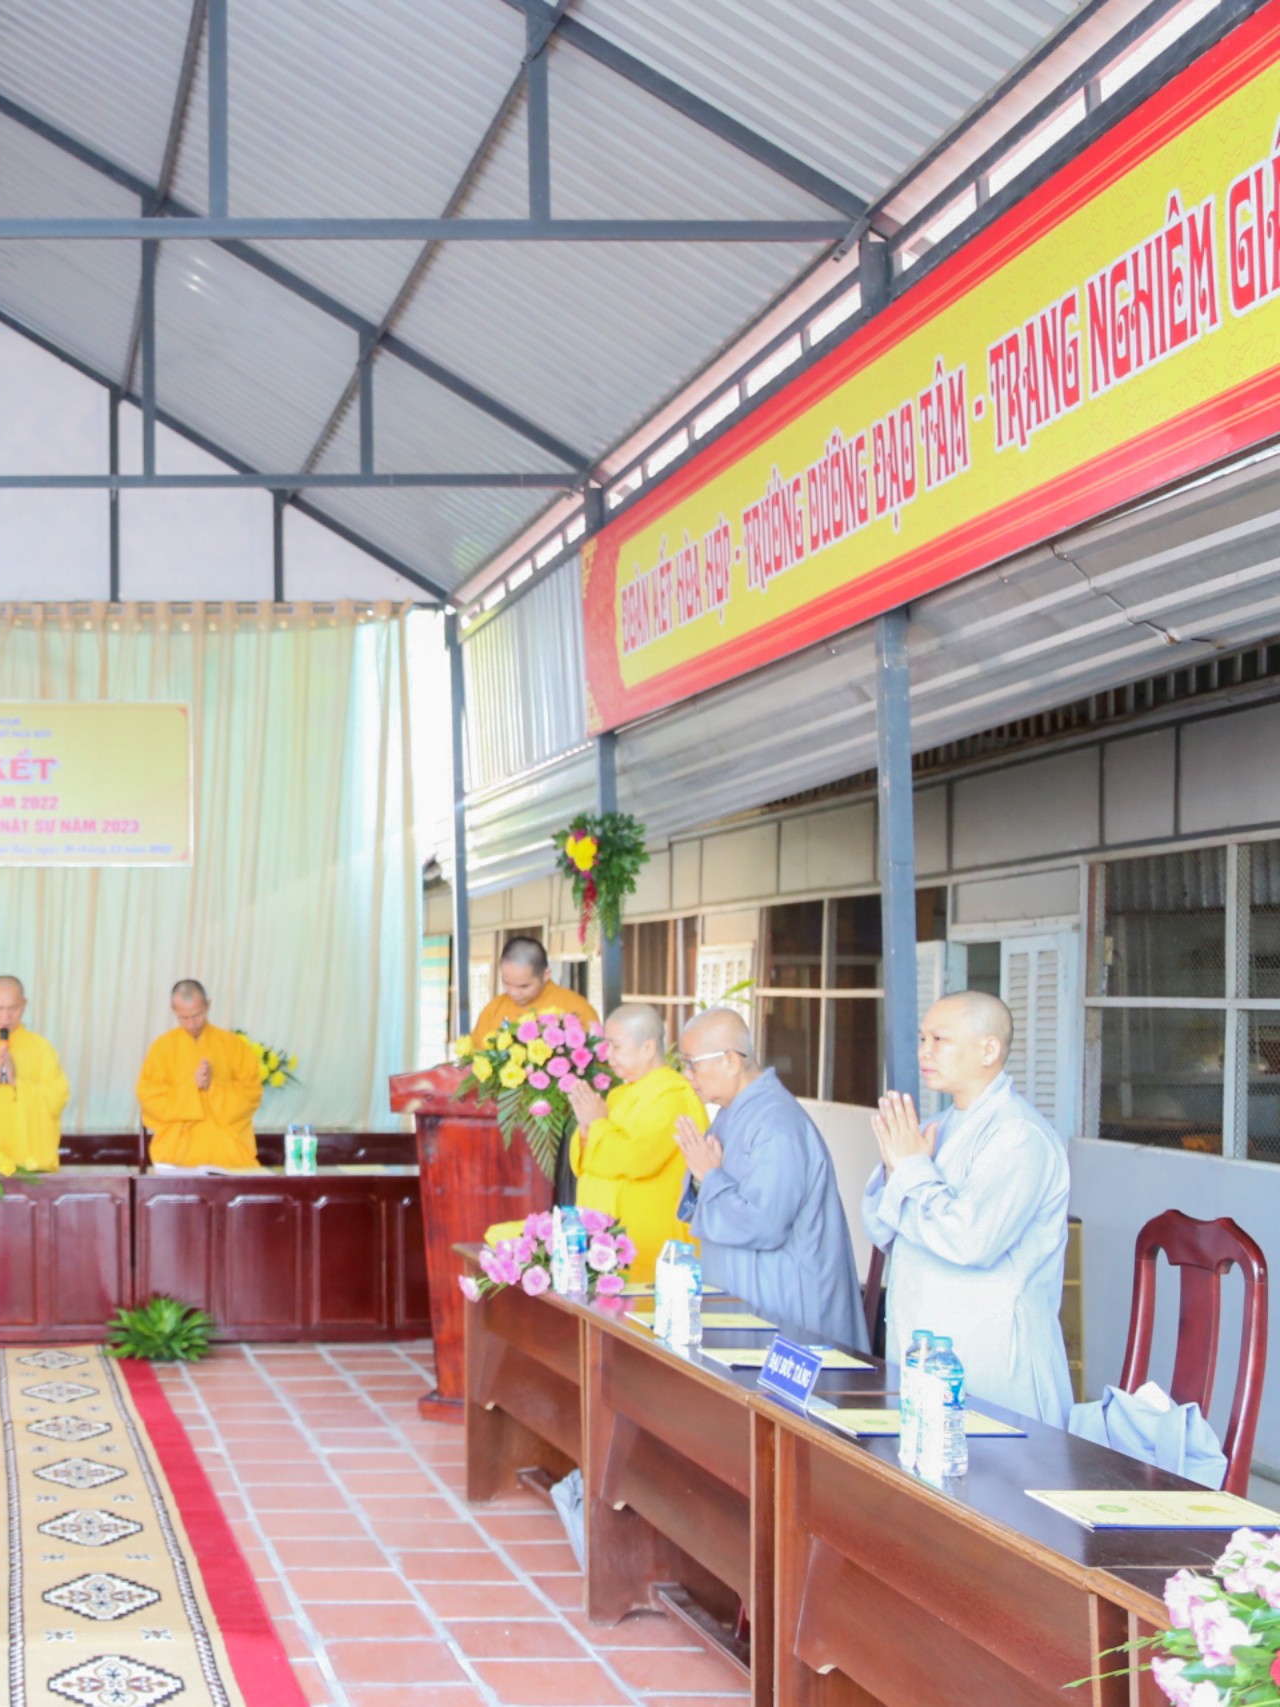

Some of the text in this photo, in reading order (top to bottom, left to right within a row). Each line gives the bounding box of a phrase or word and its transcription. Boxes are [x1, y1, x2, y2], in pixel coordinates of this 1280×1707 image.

[872, 403, 916, 530] ĐẠO
[920, 359, 969, 487] TÂM
[988, 292, 1081, 447] TRANG
[1087, 194, 1218, 394] NGHIÊM
[21, 795, 60, 810] 2022
[34, 817, 57, 836] SỰ
[60, 817, 97, 833] NĂM
[102, 818, 140, 833] 2023
